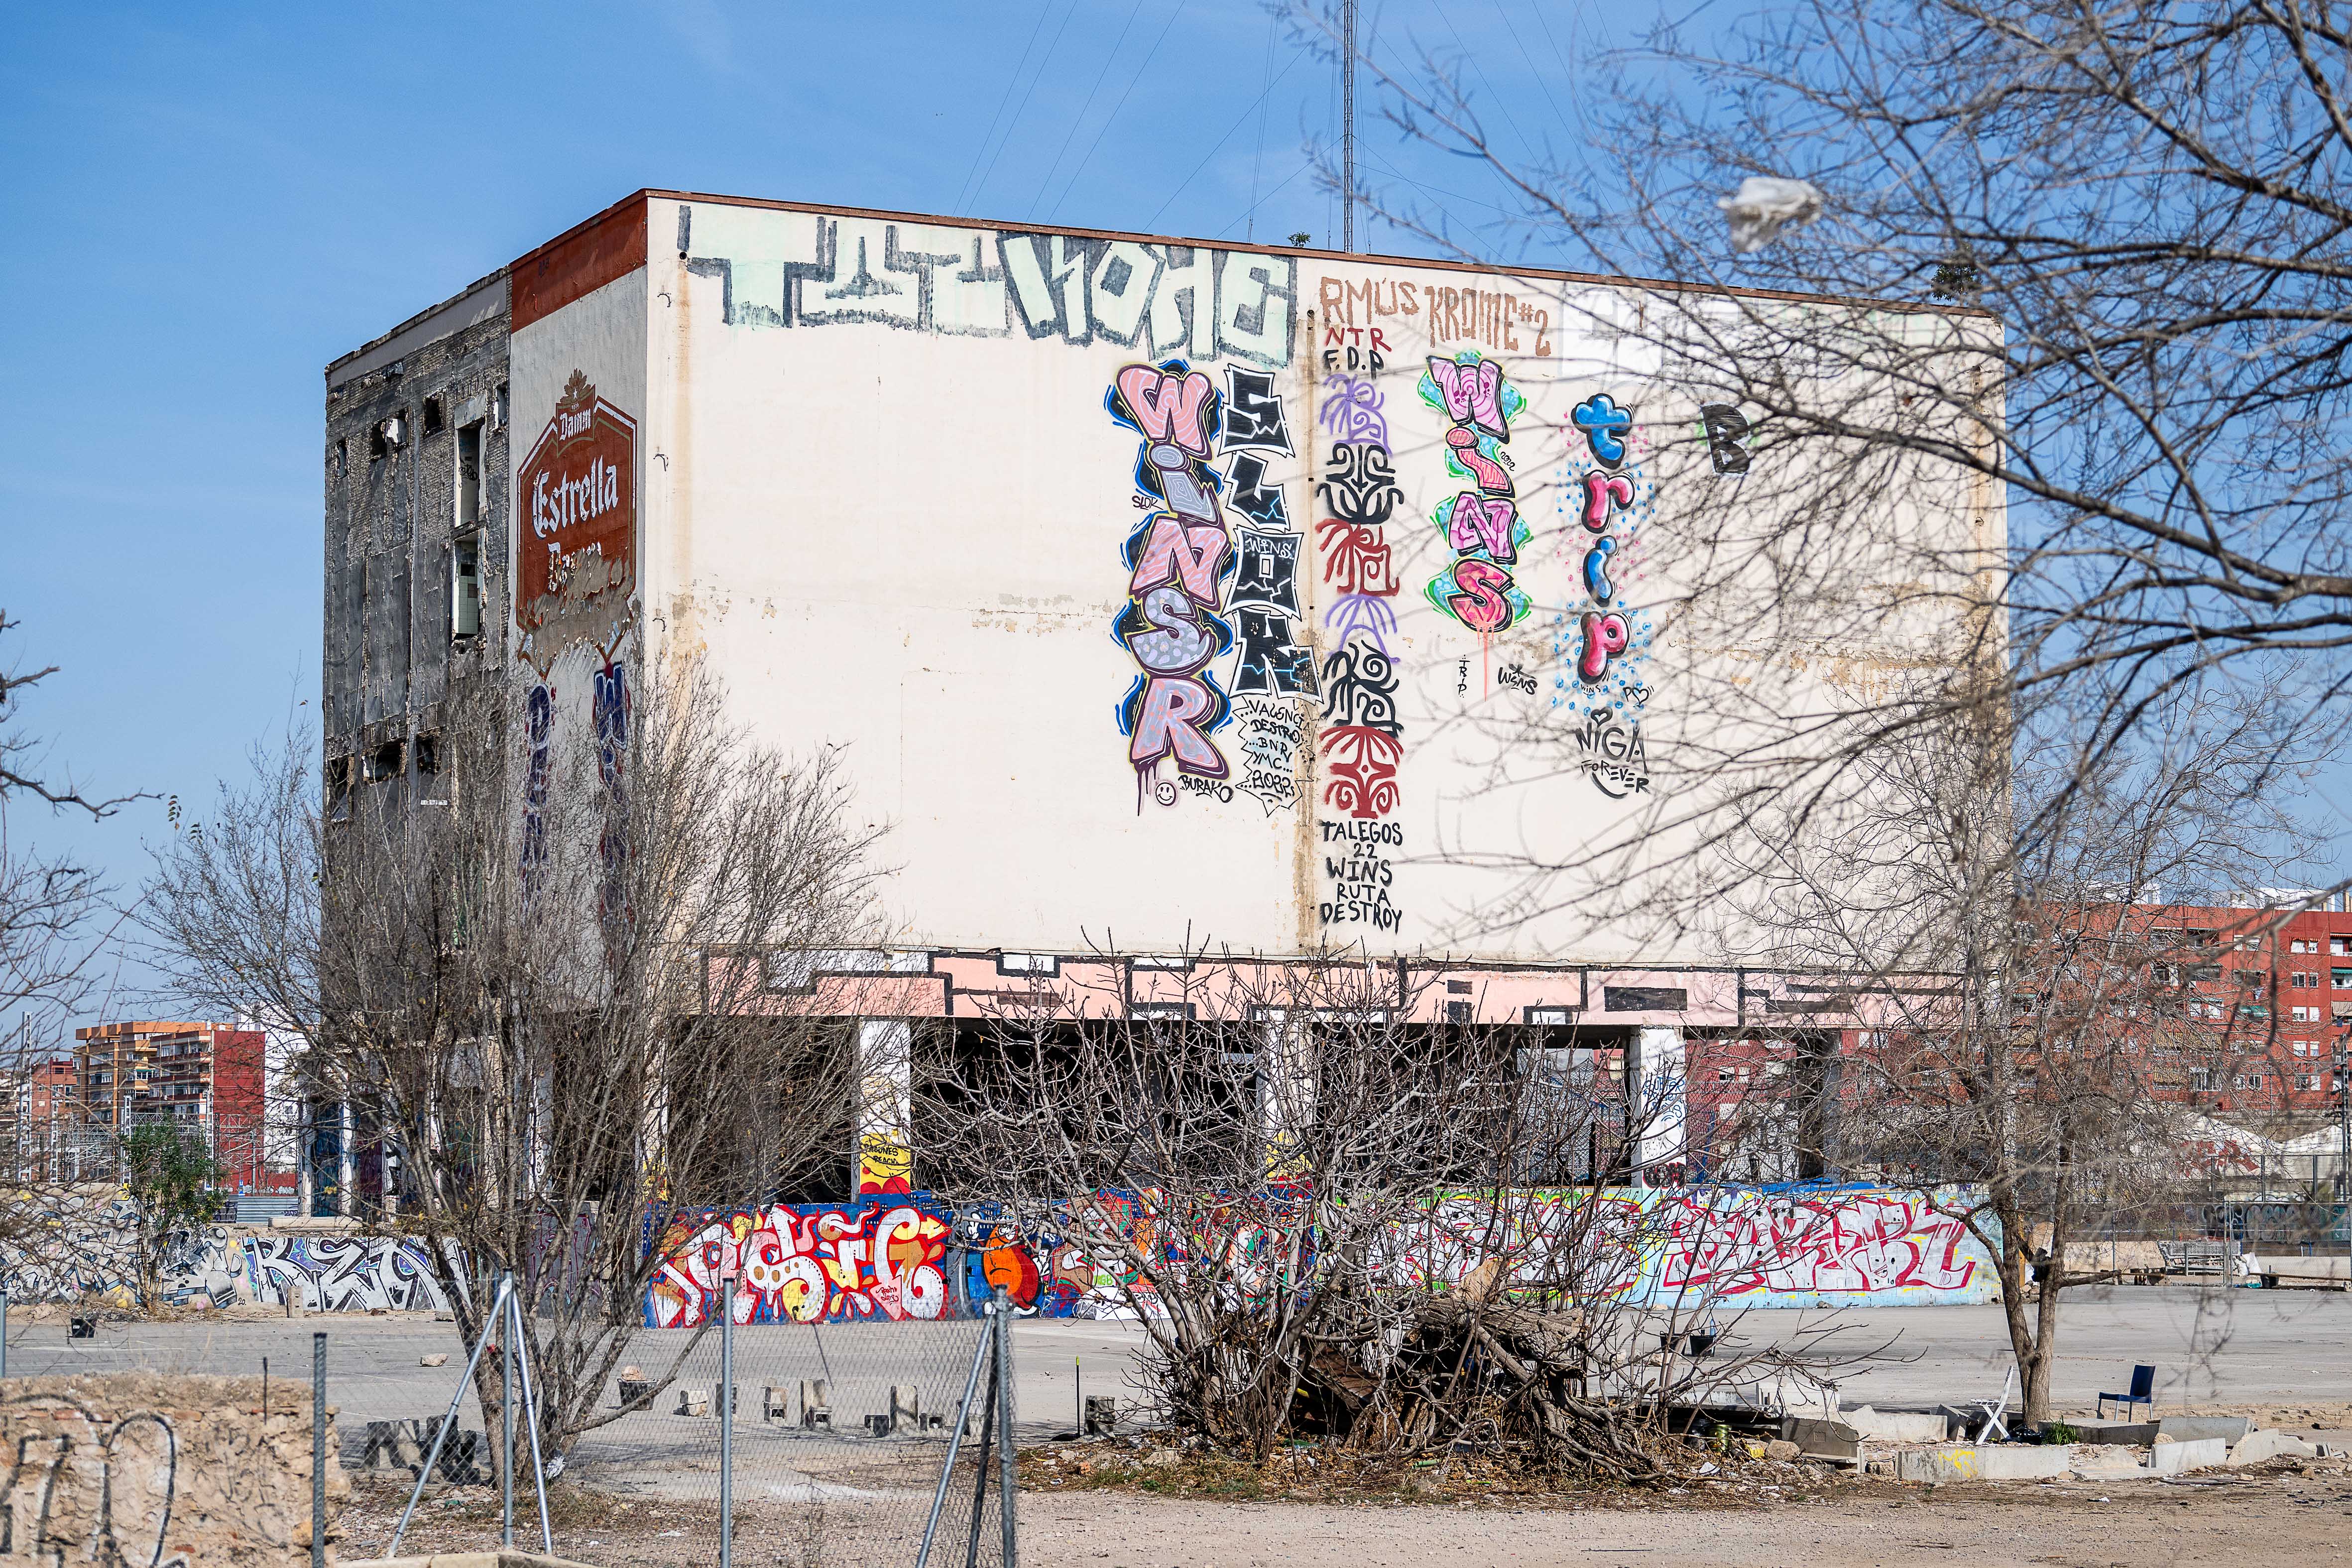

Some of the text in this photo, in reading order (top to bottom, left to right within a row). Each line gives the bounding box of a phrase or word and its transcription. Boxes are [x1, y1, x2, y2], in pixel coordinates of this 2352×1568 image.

[1324, 327, 1392, 352] NTR
[559, 409, 591, 441] Damm
[1501, 451, 1516, 472] 2022
[532, 455, 618, 538] Estrella
[1457, 660, 1471, 696] TRIP
[1177, 774, 1234, 803] BURAKO
[1321, 821, 1403, 846] TALEGOS
[1353, 843, 1378, 859] 22
[1326, 857, 1393, 887] WINS
[1337, 882, 1391, 907] RUTA
[1319, 901, 1403, 935] DESTROY
